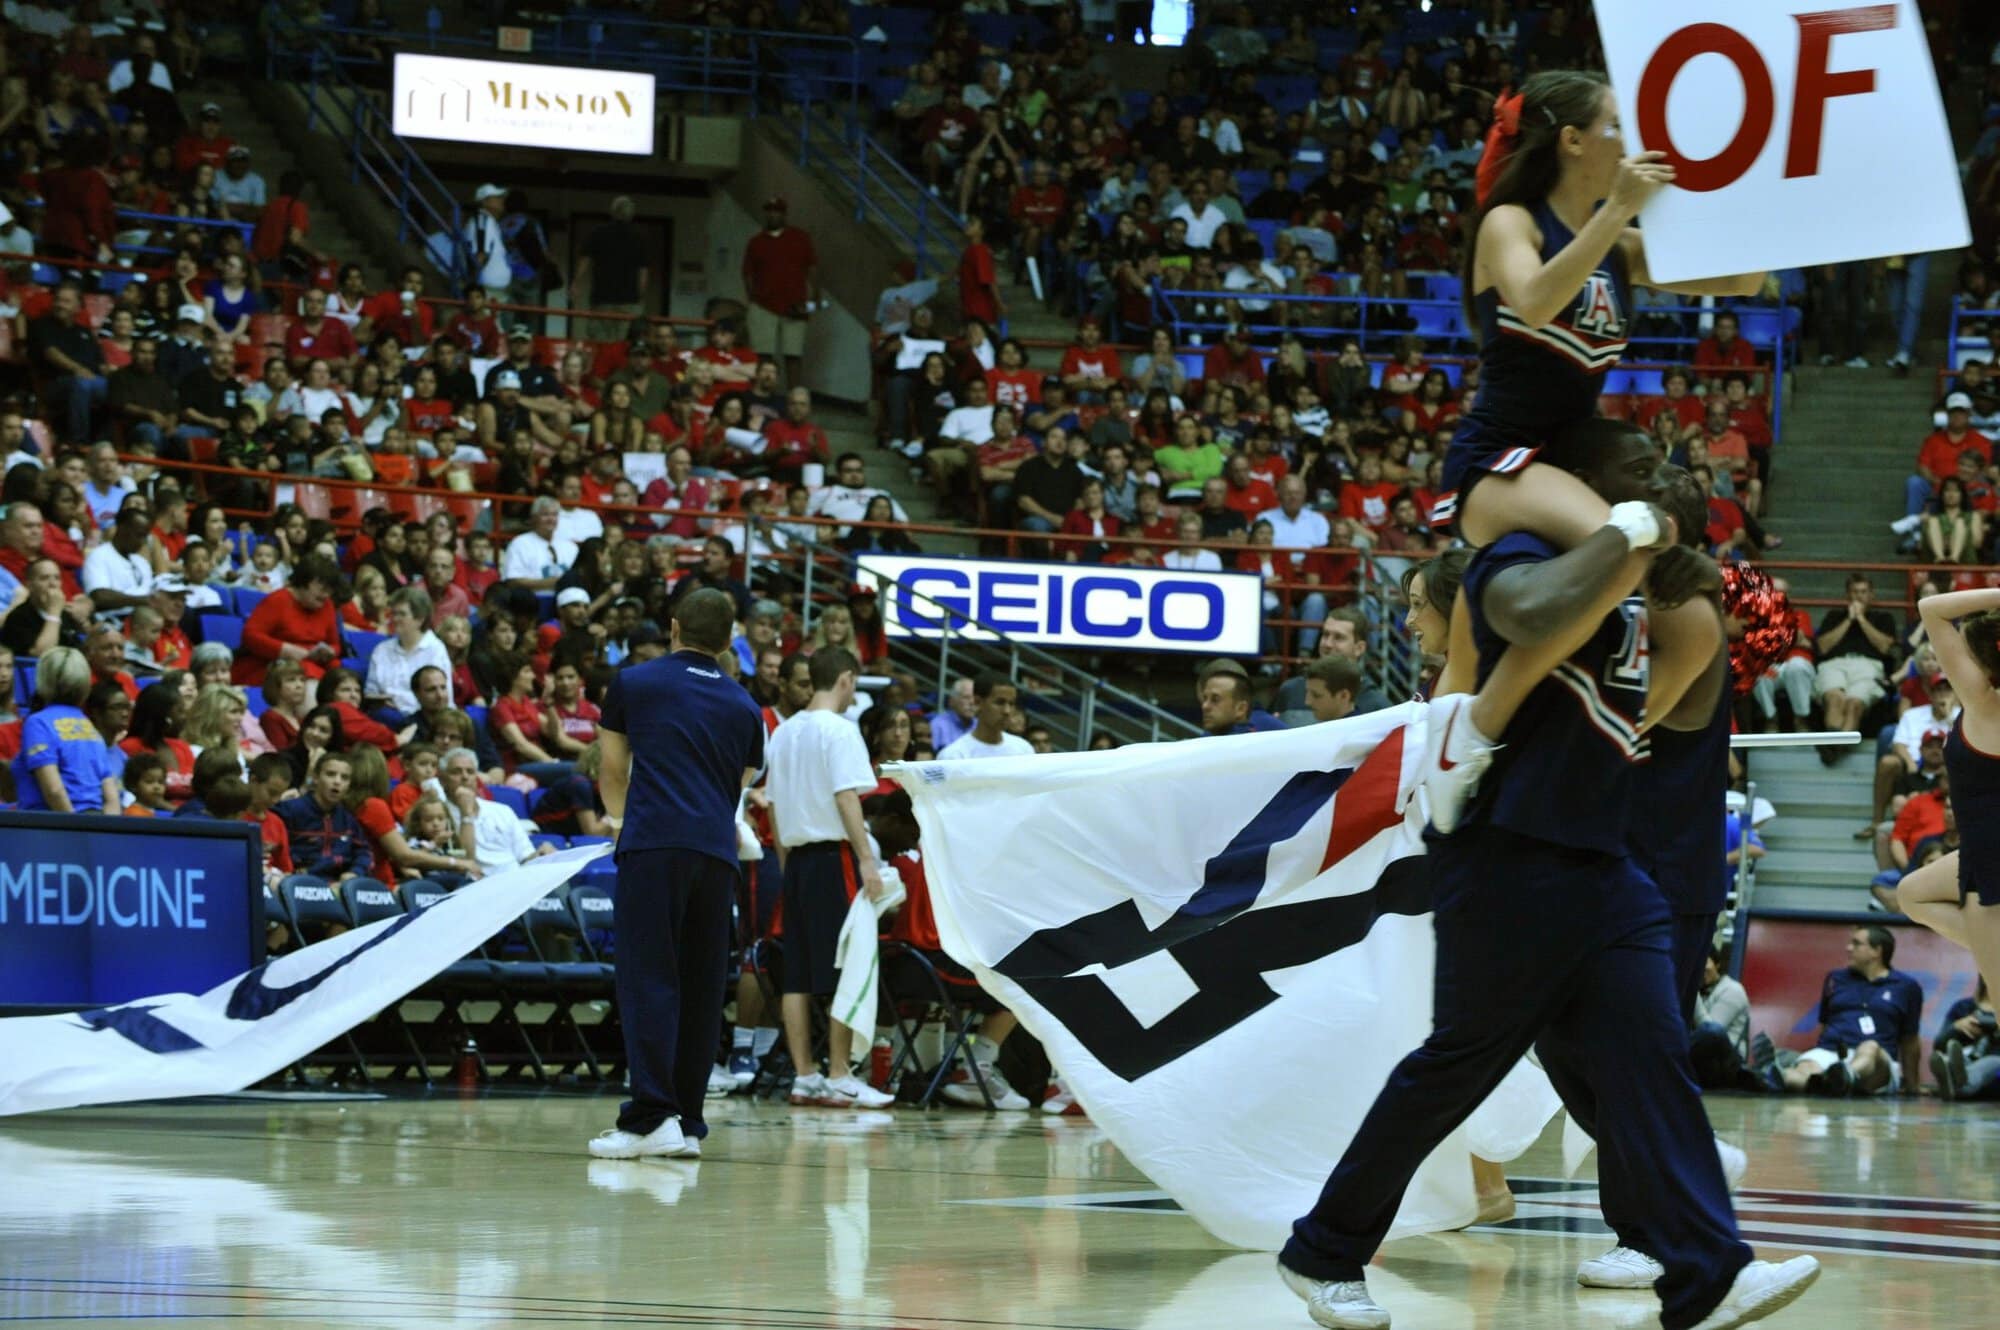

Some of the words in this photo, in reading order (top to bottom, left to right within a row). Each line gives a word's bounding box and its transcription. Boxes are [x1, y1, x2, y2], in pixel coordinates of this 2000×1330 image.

[1636, 3, 1897, 192] OF
[1573, 269, 1626, 339] A
[896, 567, 1225, 642] GEICO
[0, 862, 207, 929] MEDICINE
